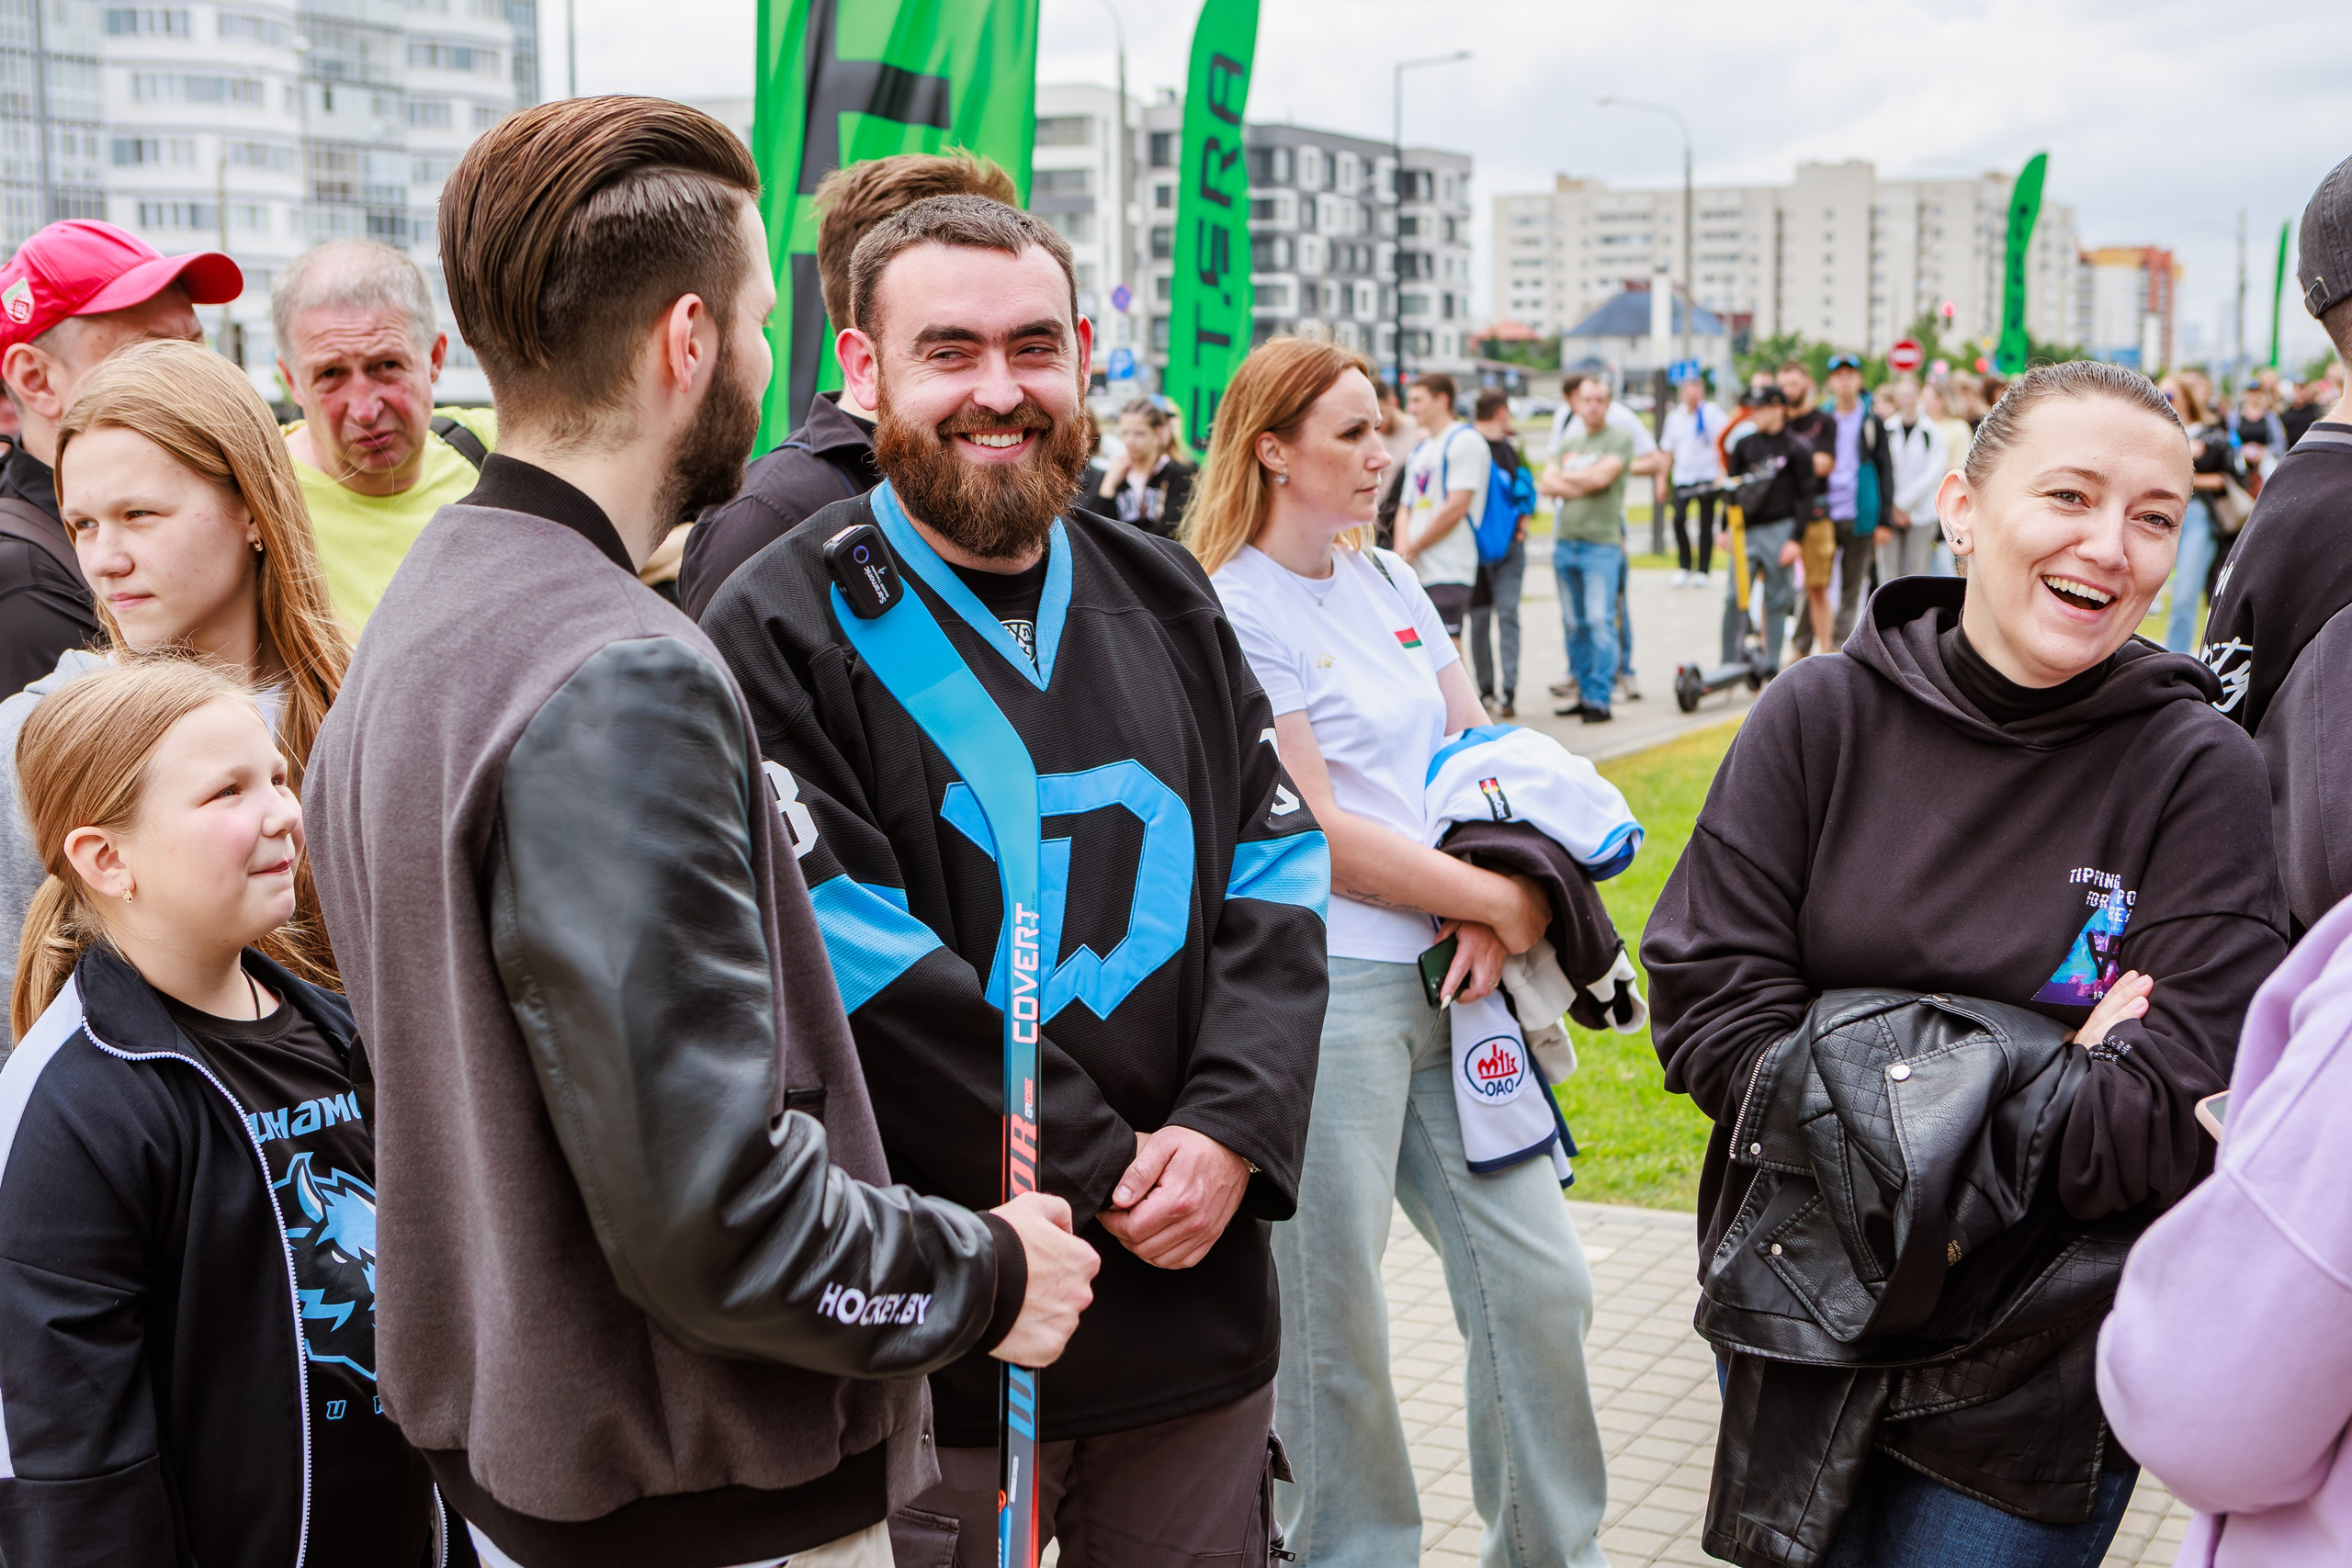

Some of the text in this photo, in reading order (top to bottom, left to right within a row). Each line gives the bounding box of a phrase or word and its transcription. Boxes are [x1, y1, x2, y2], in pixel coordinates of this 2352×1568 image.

[864, 565, 887, 604] Saramonic
[2069, 867, 2121, 890] TIPPING
[1012, 902, 1039, 1043] COVERT
[817, 1280, 933, 1326] HOCKEY.BY
